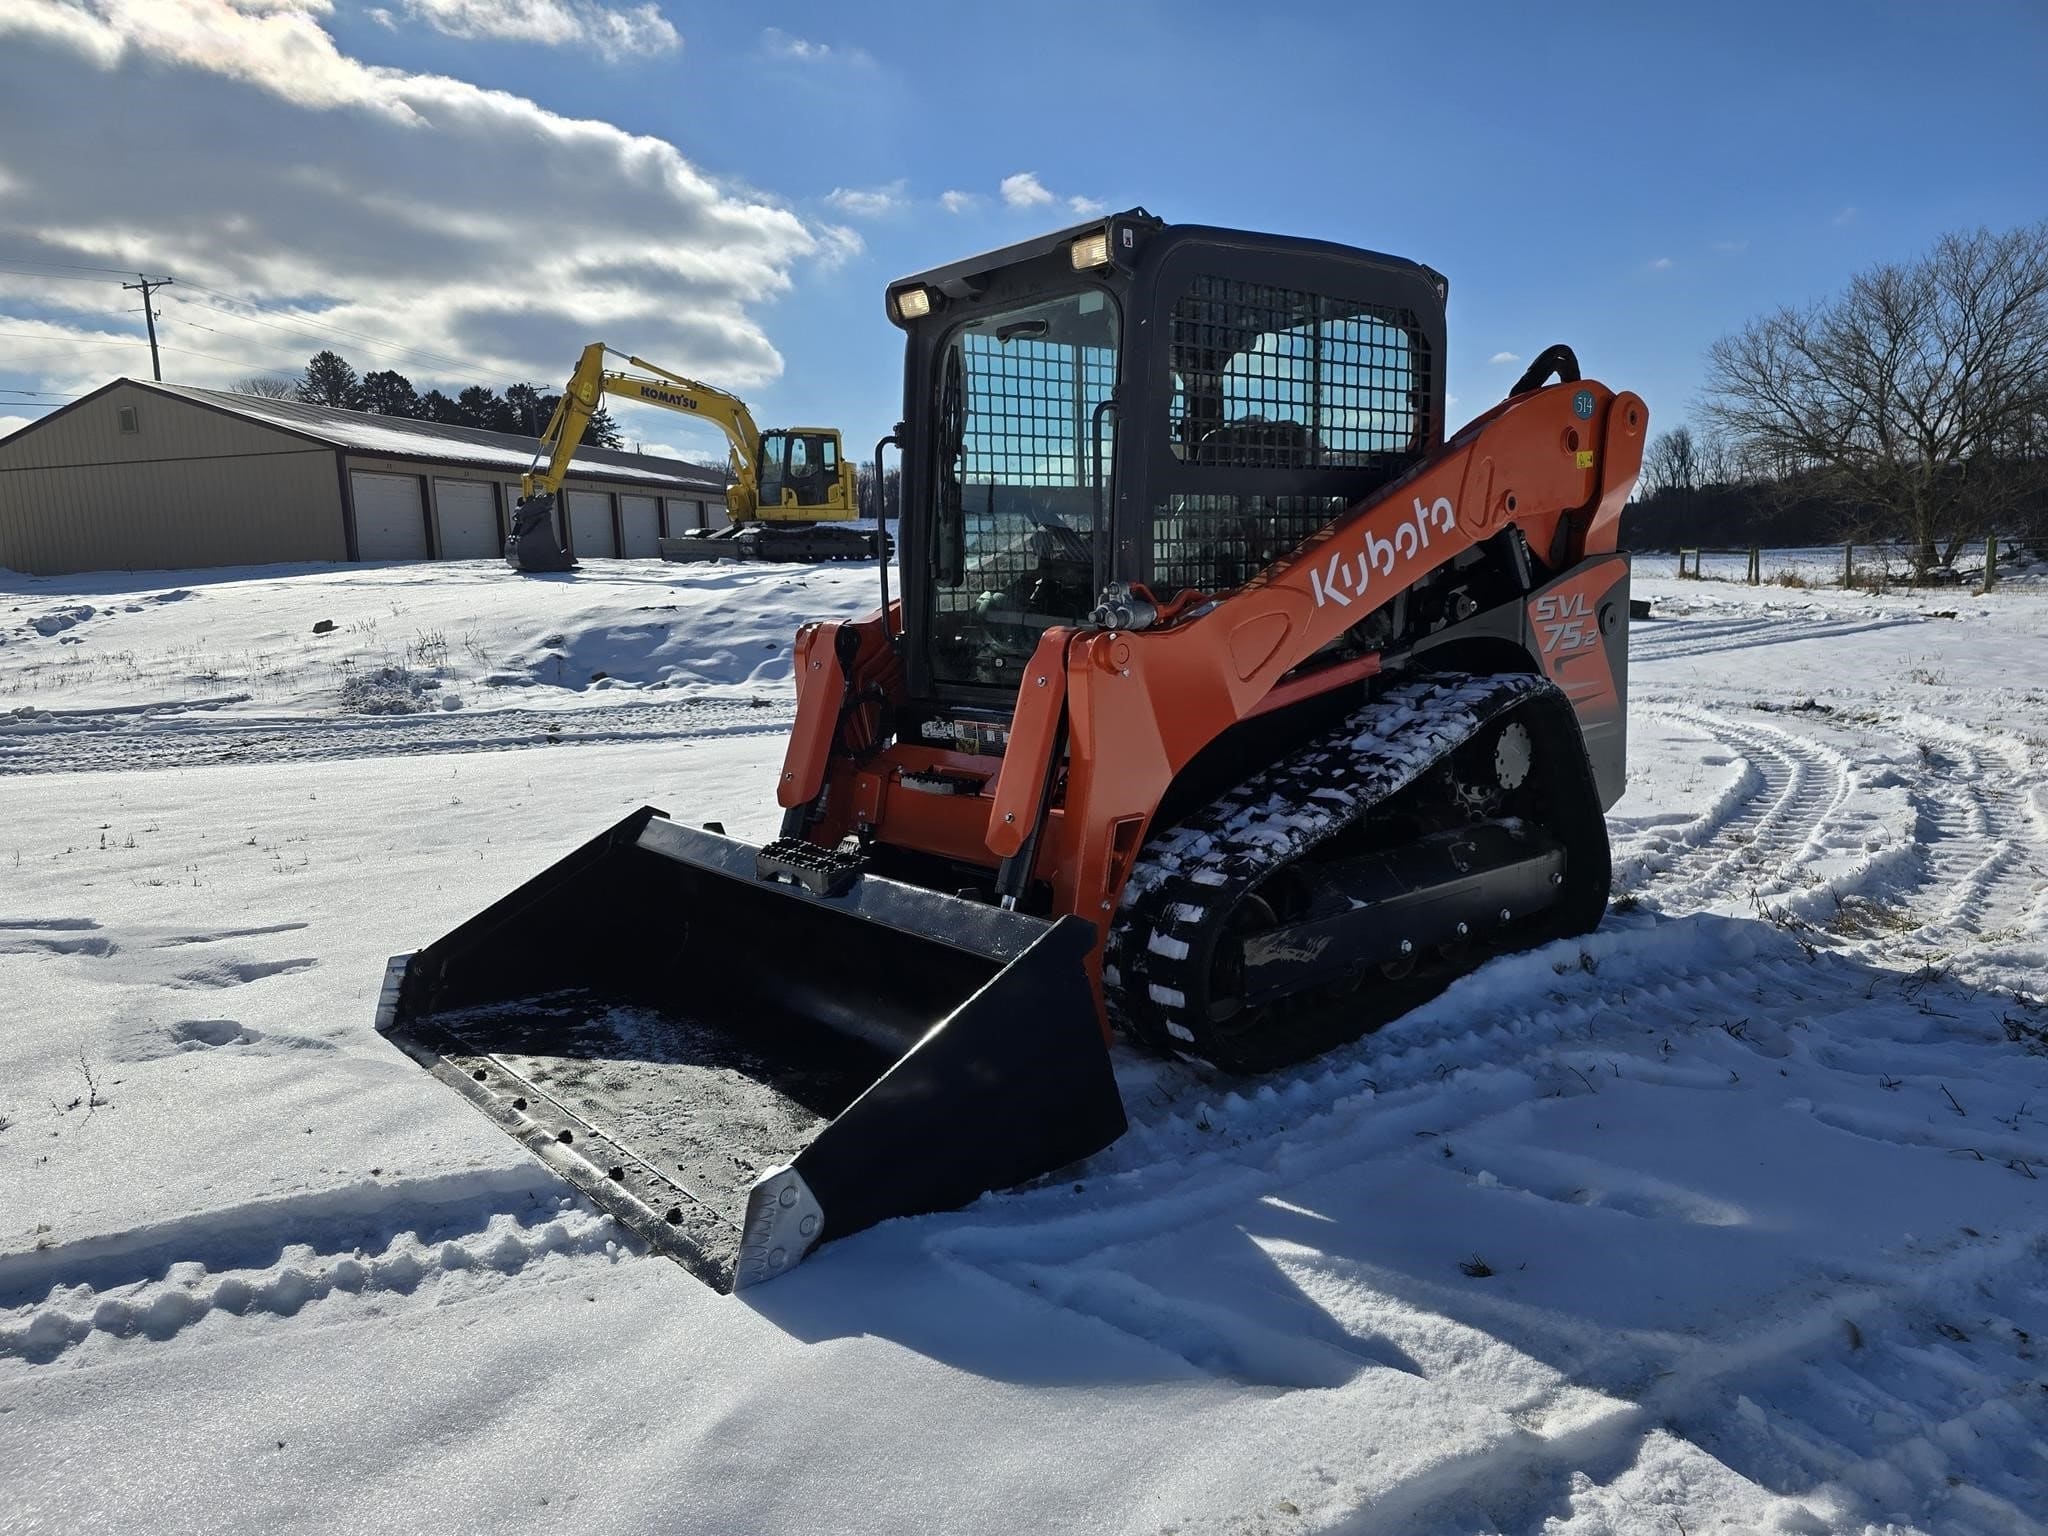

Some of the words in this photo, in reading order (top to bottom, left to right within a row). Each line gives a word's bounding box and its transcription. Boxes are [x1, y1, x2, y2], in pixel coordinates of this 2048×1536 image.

[640, 386, 698, 410] KOMATSU
[1576, 397, 1593, 415] 514
[1310, 497, 1456, 608] Kubota
[1535, 592, 1594, 623] SVL
